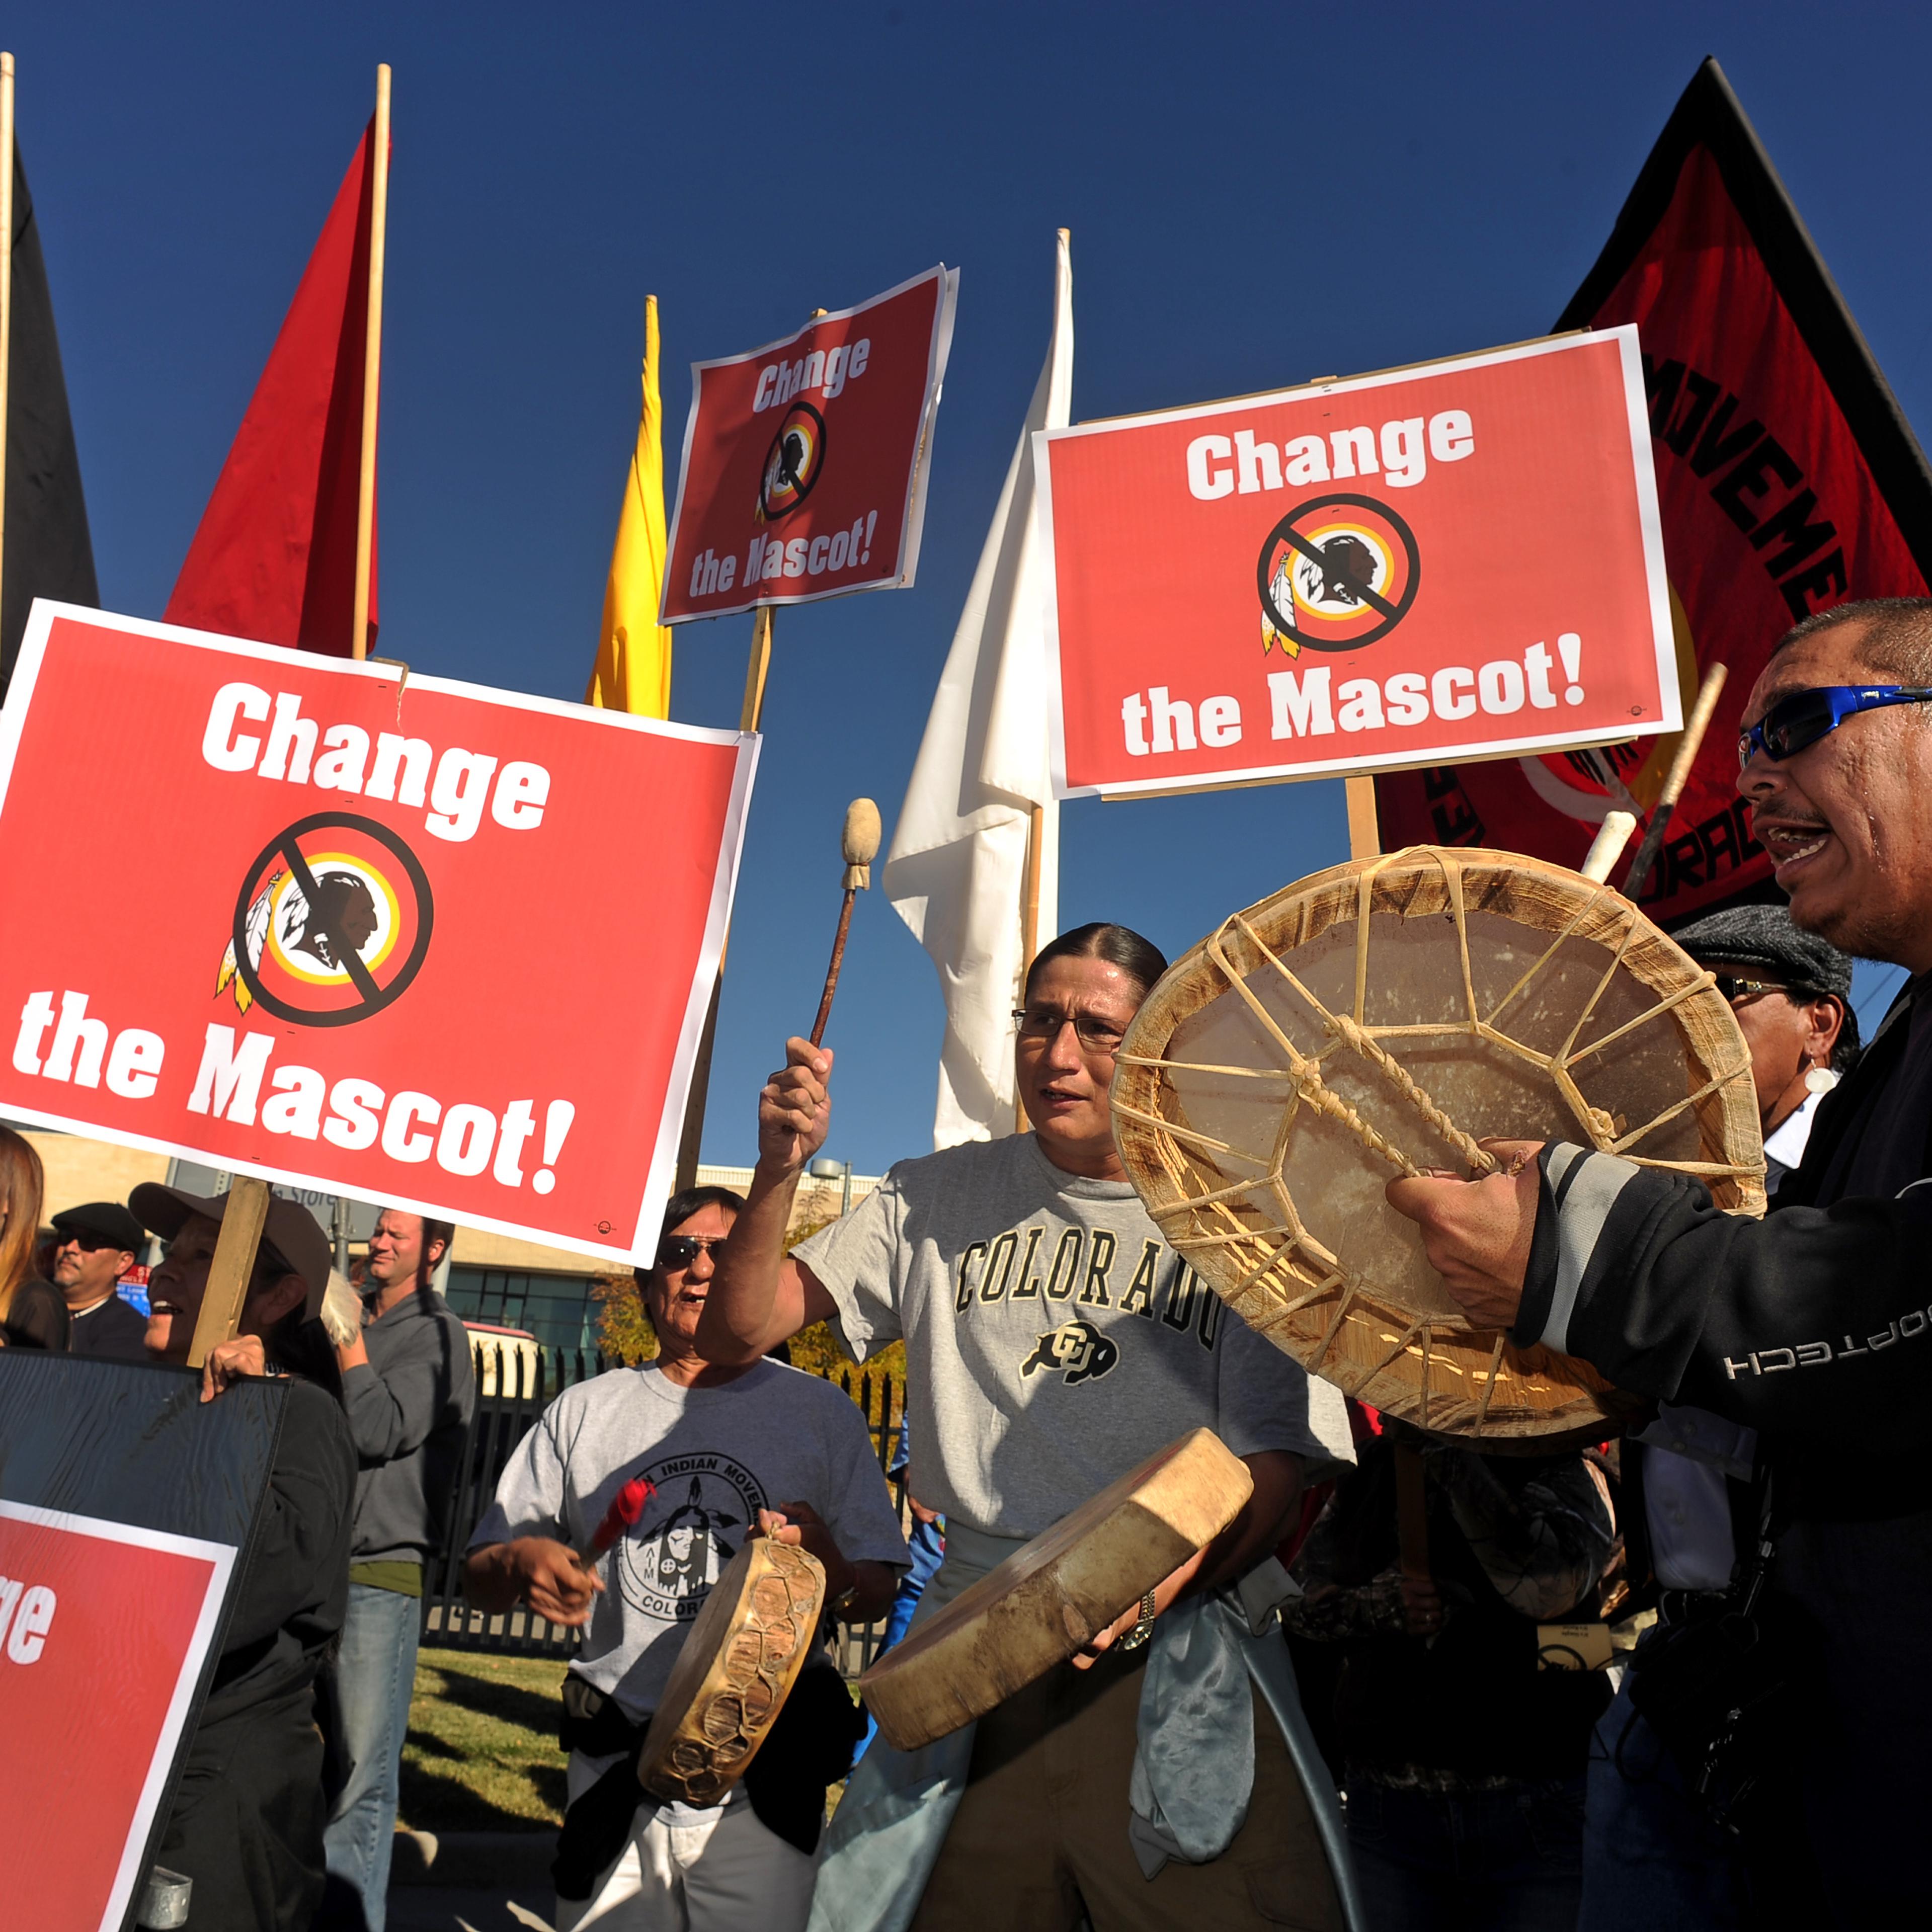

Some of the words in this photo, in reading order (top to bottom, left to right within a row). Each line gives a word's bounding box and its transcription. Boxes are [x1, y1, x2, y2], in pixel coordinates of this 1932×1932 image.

[752, 338, 871, 413] Change
[1186, 410, 1475, 501] Change
[689, 549, 736, 597] the
[1121, 686, 1242, 756] the
[1267, 632, 1585, 740] Mascot!
[202, 682, 551, 842] Change
[13, 990, 165, 1099] the
[187, 1023, 575, 1195] Mascot!
[661, 1458, 718, 1477] INDIAN
